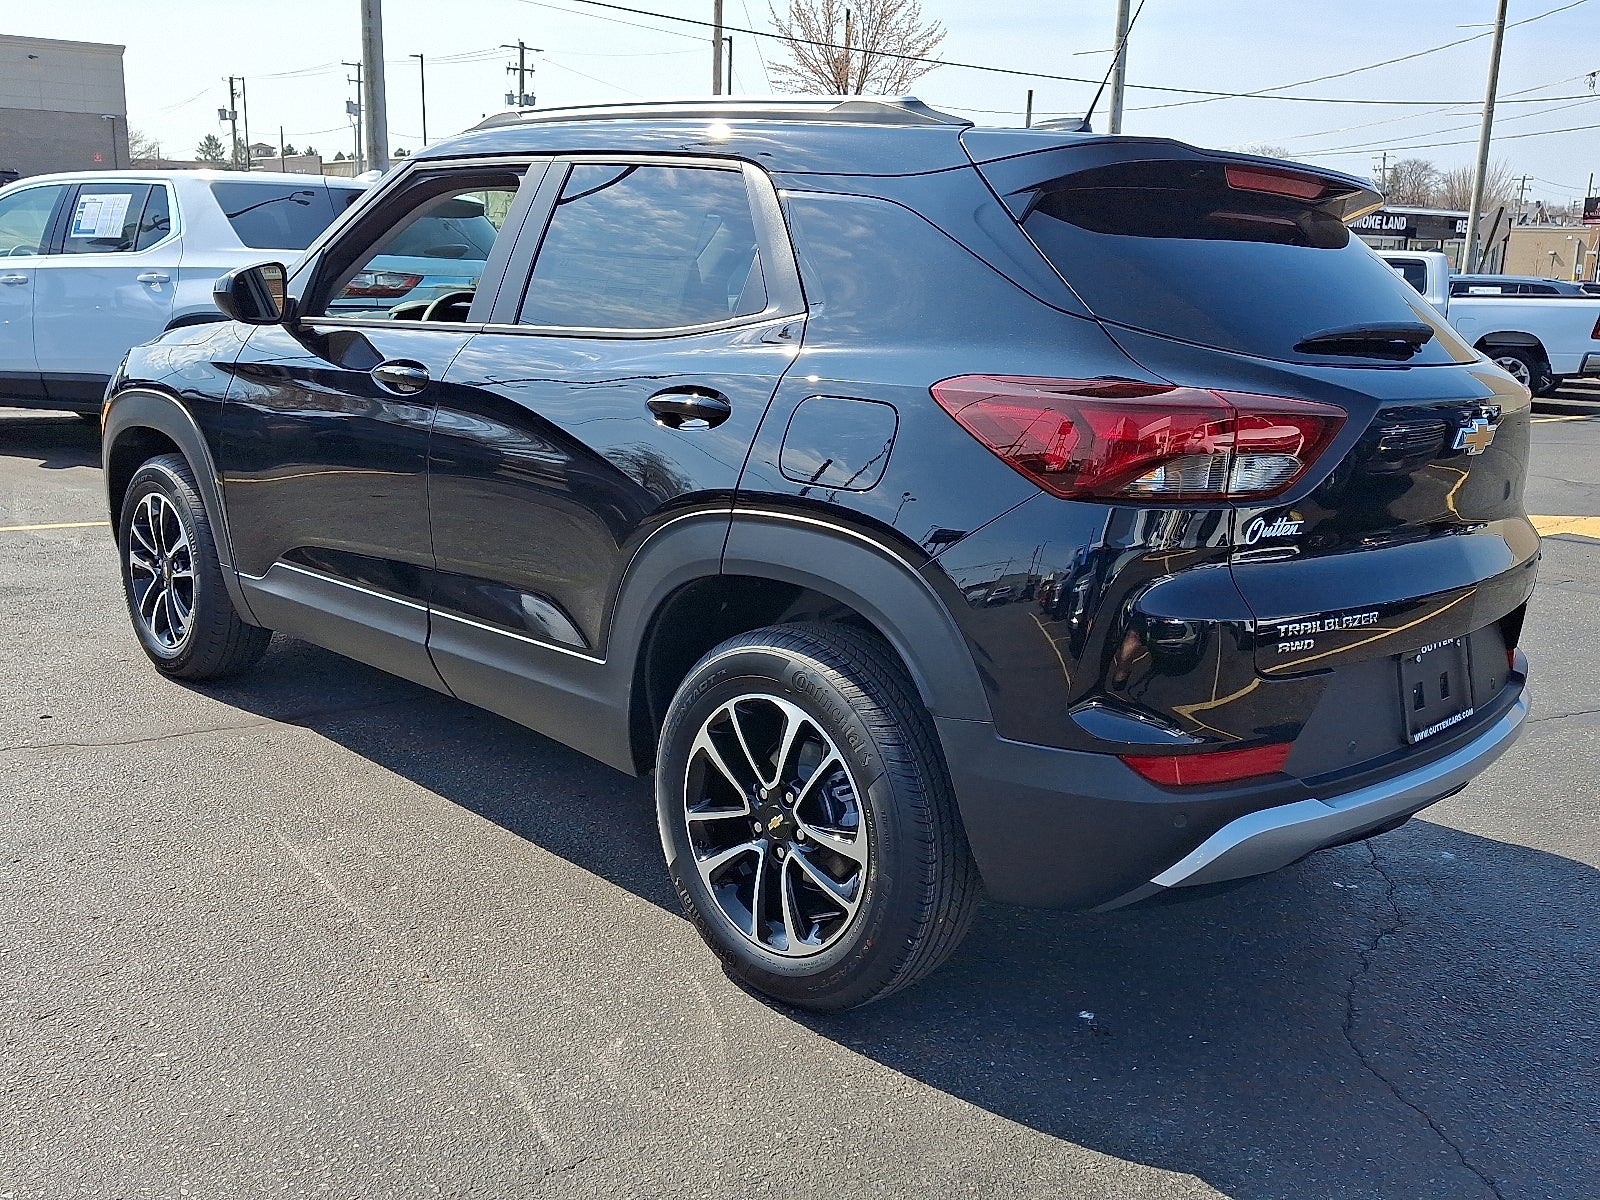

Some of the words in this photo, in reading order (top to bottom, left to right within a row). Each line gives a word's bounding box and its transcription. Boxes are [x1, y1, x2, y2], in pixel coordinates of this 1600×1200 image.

[1348, 214, 1382, 230] MOKE
[1382, 215, 1407, 231] LAND
[1245, 516, 1305, 545] Outten
[1277, 611, 1379, 637] TRAILBLAZER
[1277, 638, 1315, 654] AWD
[791, 670, 867, 754] Continental
